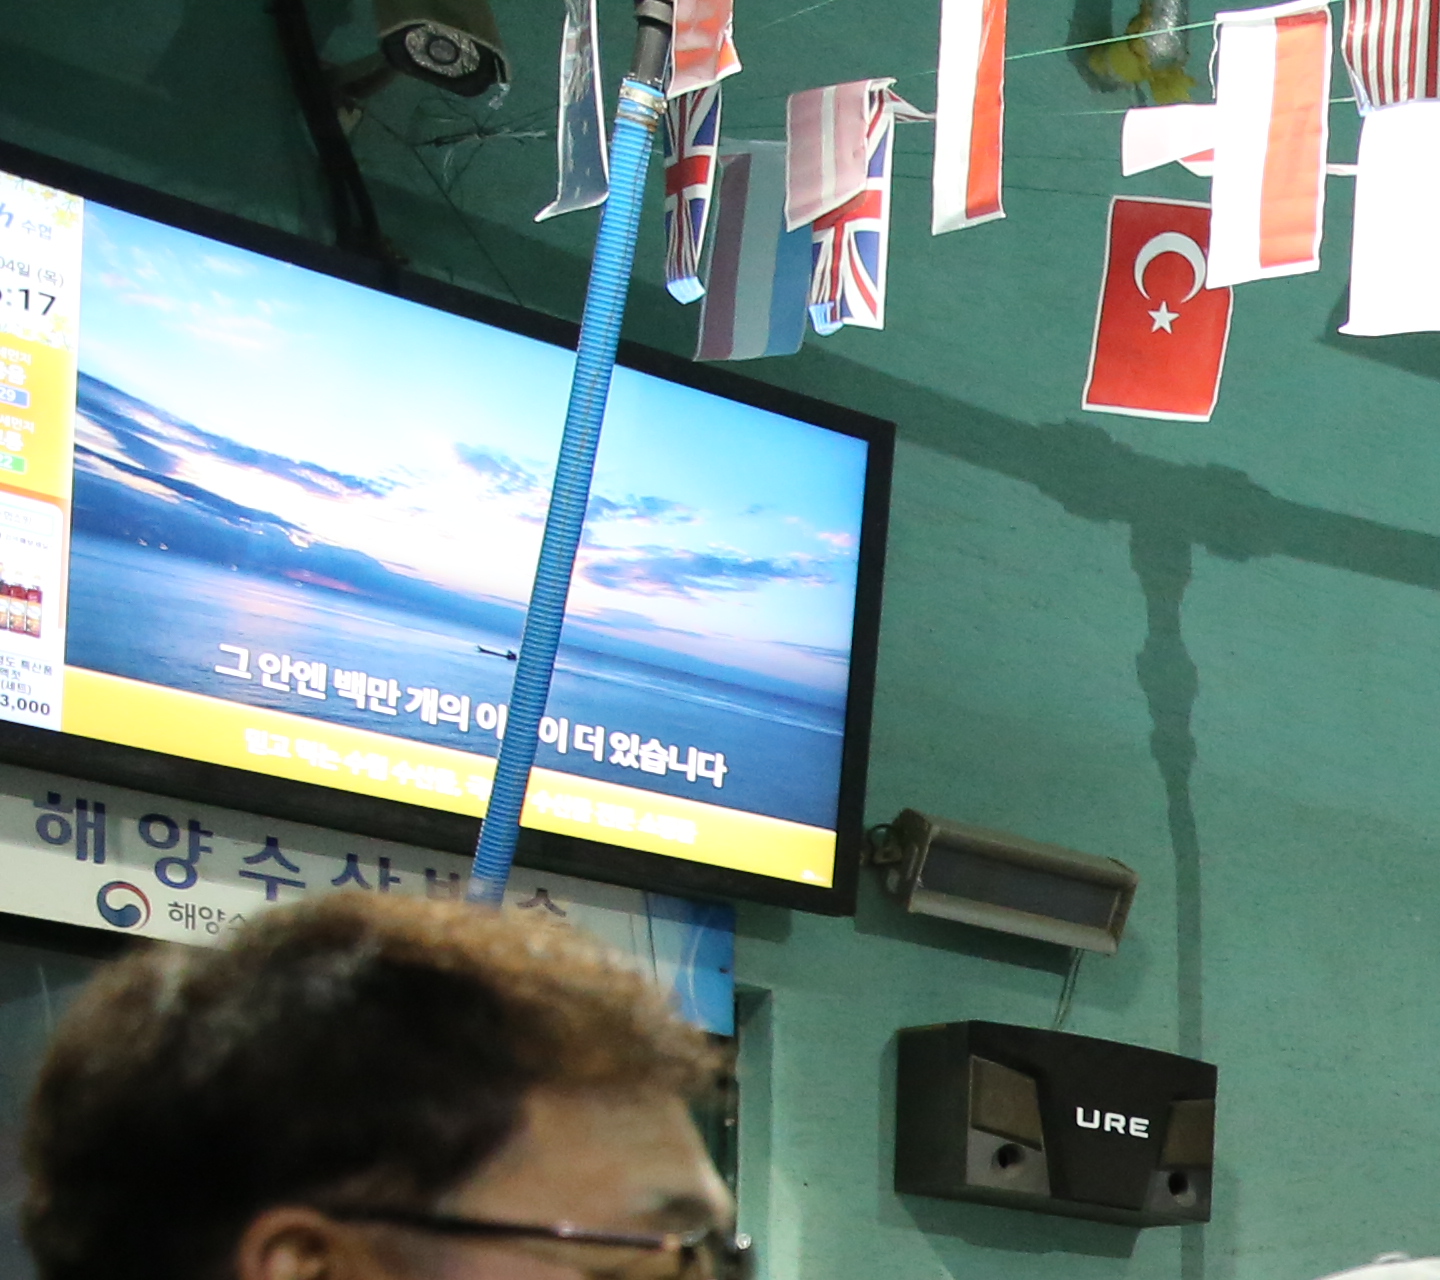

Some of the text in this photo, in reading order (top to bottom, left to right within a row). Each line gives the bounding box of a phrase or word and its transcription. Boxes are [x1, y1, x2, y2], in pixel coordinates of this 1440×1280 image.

[21, 219, 52, 240] 수협
[0, 288, 56, 315] :17
[214, 642, 729, 789] 그 안엔 백만 개의 이이 더 있습니다
[1075, 1106, 1150, 1139] URE
